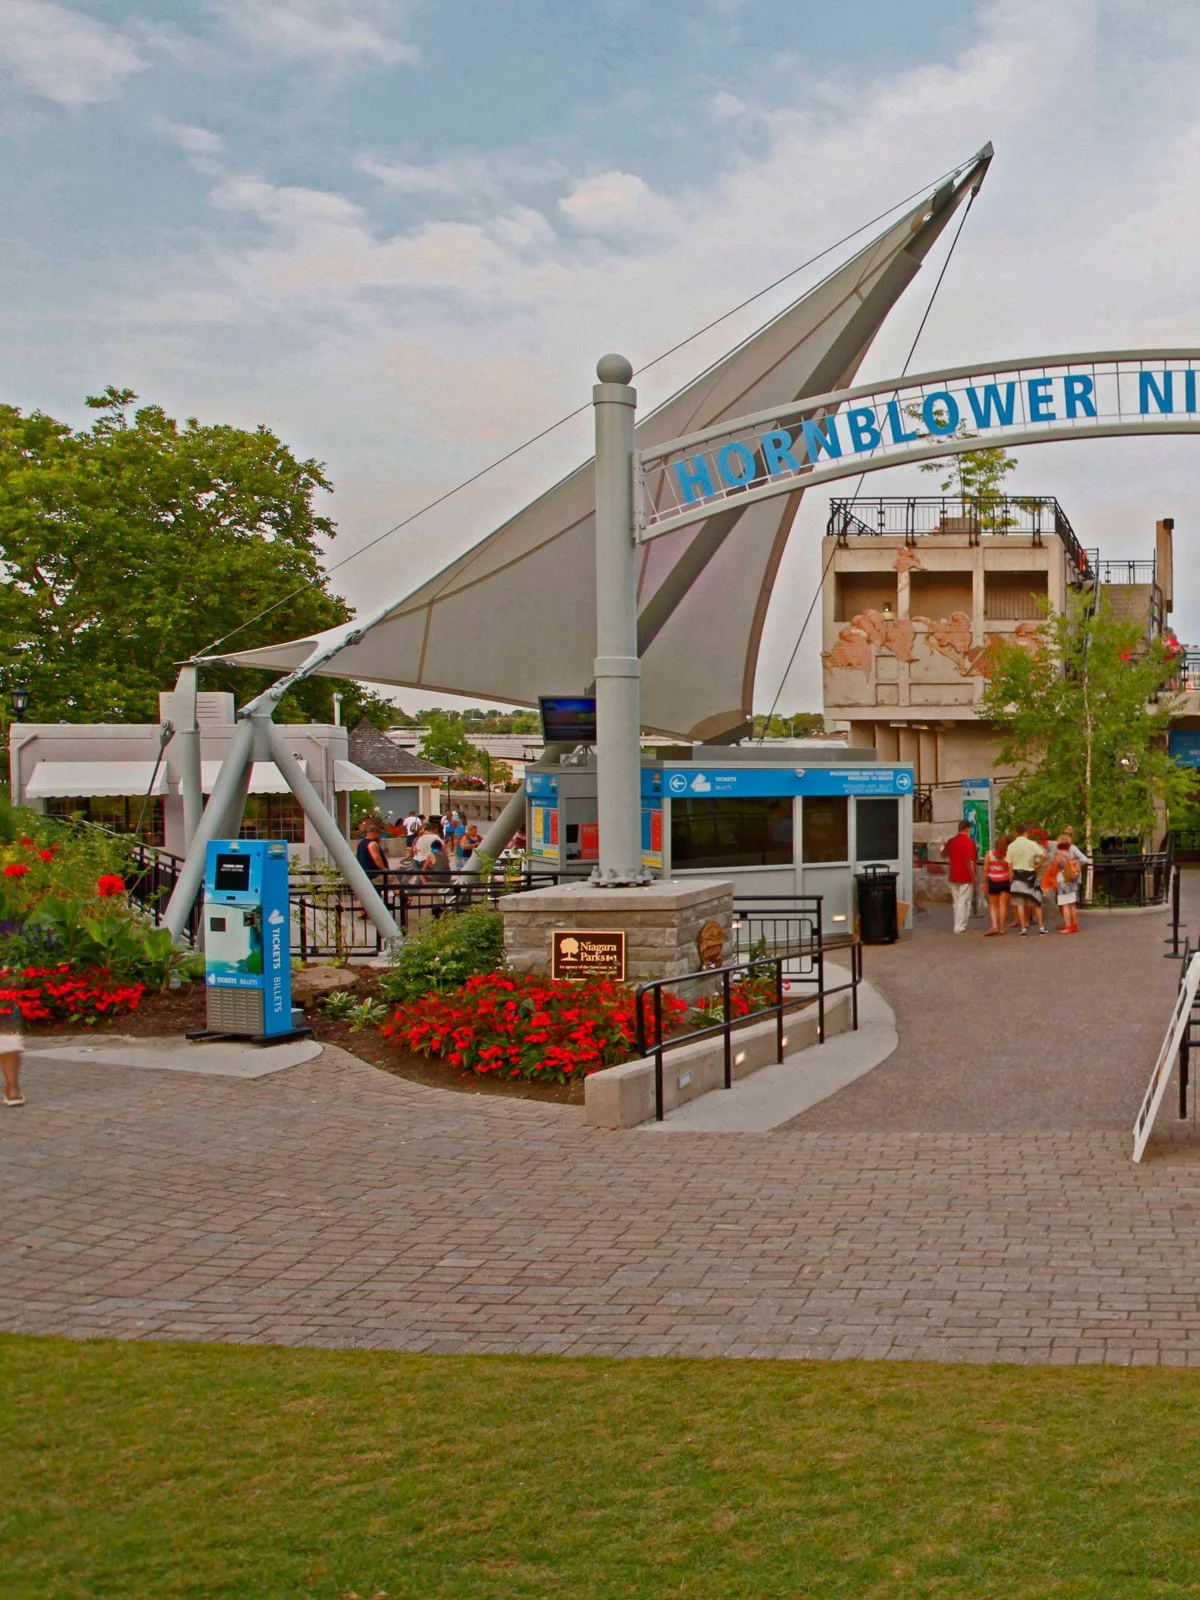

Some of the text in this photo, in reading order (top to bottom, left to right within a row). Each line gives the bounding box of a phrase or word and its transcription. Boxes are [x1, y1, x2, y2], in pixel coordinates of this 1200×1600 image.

[675, 374, 1097, 504] HORNBLOWER
[580, 941, 617, 954] Niagara
[580, 951, 606, 962] Parks
[272, 928, 283, 1013] TICKETS BILLETS
[217, 976, 237, 984] TICKETS
